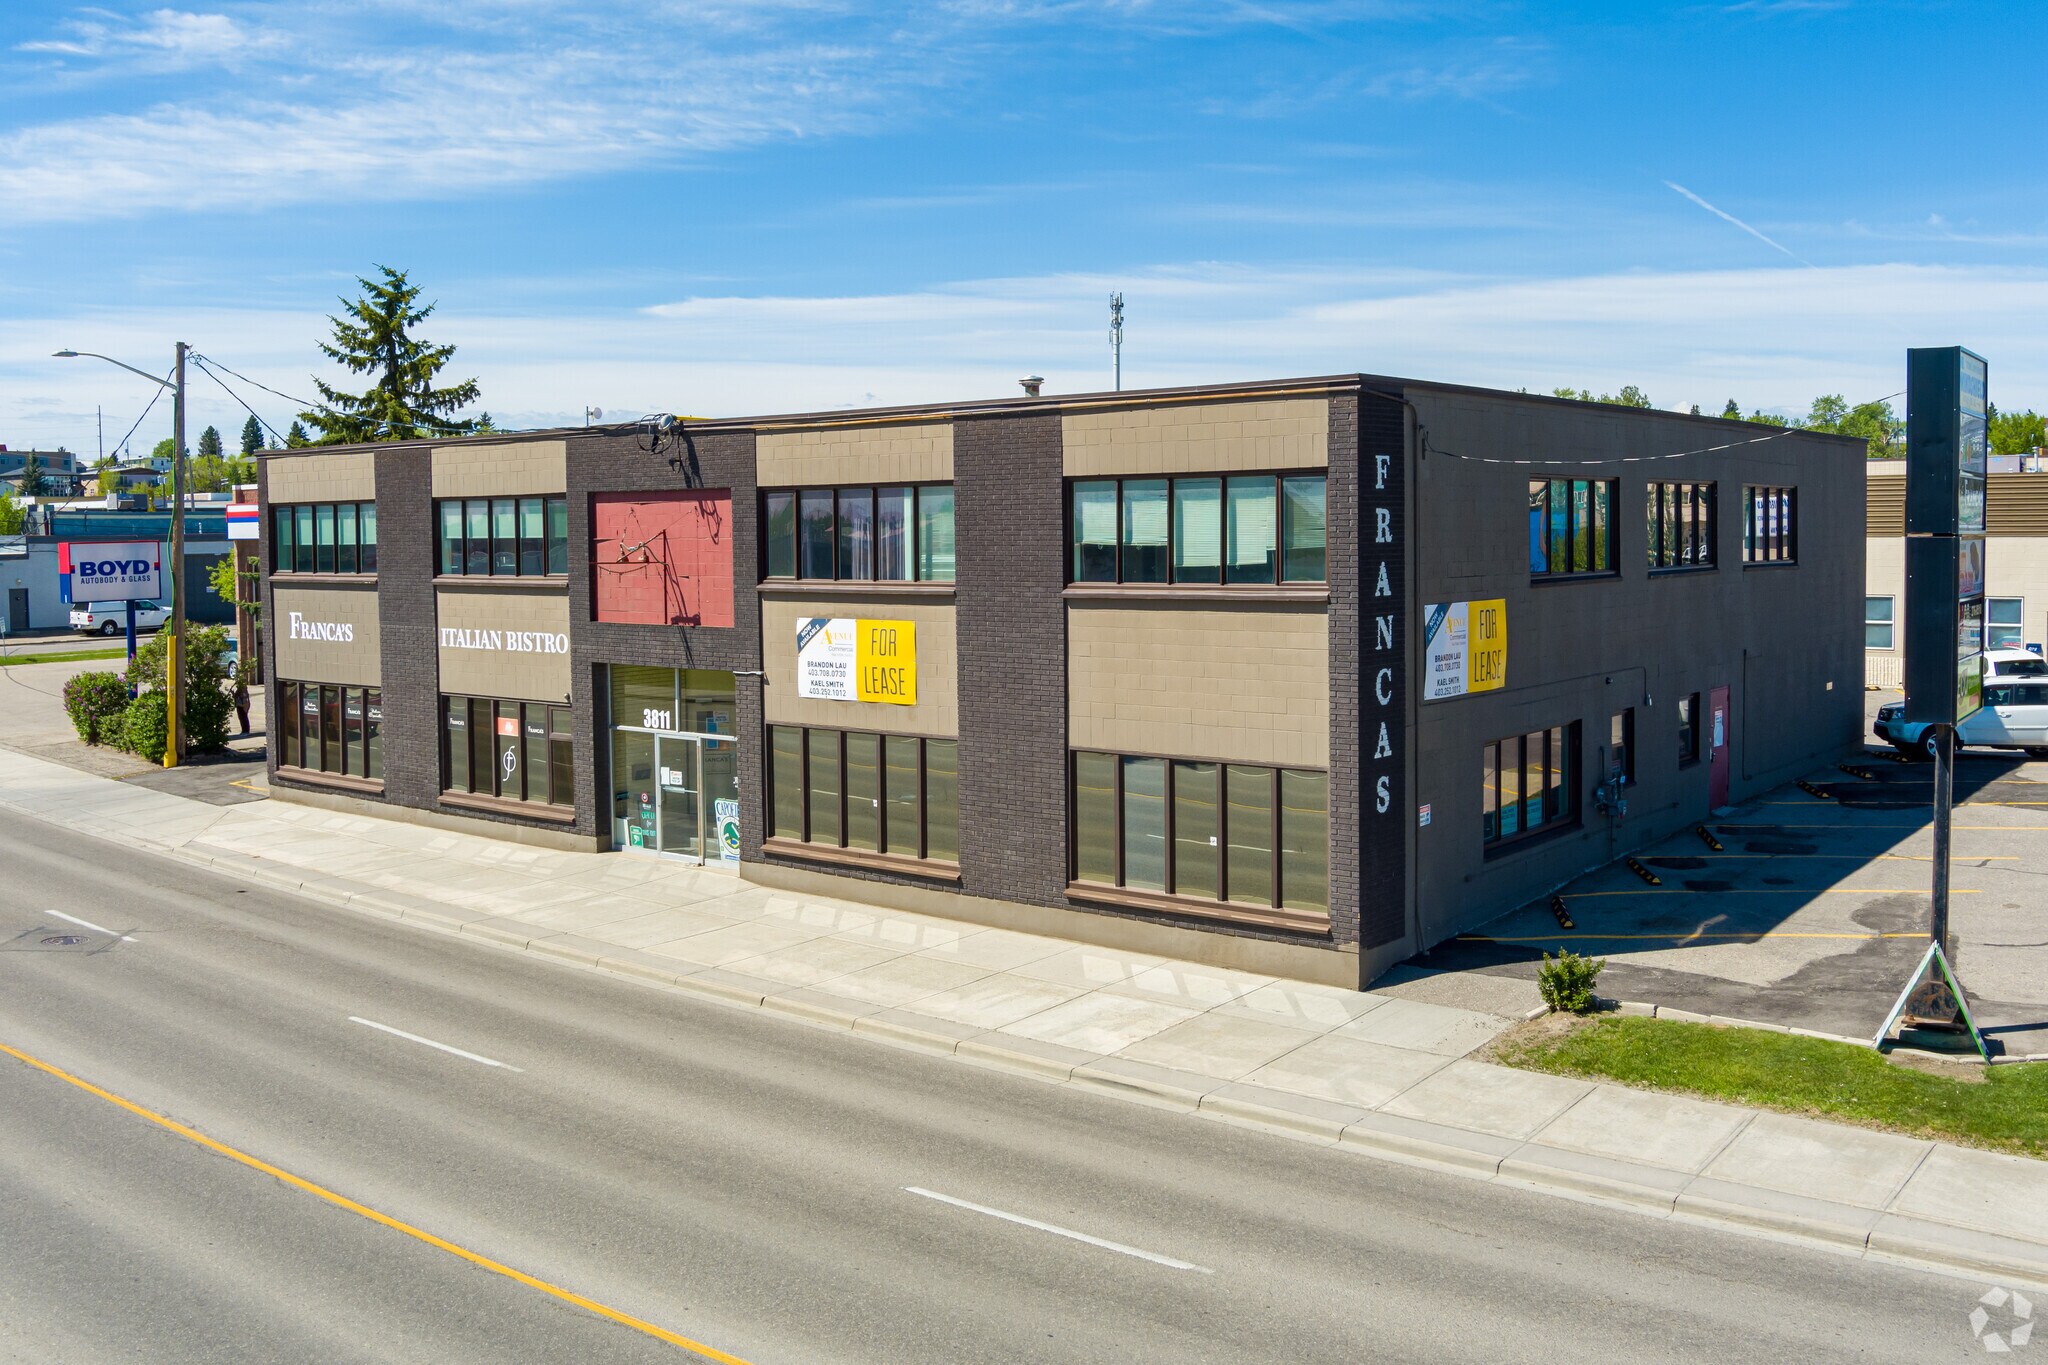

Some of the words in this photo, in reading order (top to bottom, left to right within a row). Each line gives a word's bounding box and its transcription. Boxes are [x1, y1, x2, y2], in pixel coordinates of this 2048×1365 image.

[79, 560, 150, 577] BOYD
[80, 576, 119, 585] AUTOBODY
[121, 575, 126, 583] &
[128, 575, 151, 583] GLASS
[288, 611, 354, 642] FRANCA'S
[800, 623, 812, 637] NOW
[1480, 608, 1498, 640] FOR
[440, 627, 501, 650] ITALIAN
[505, 630, 569, 654] BISTRO
[799, 623, 821, 647] AVAILABLE
[871, 628, 897, 657] FOR
[1374, 455, 1394, 813] FRANCAS
[807, 660, 834, 669] BRANDON
[1434, 653, 1453, 663] BRANDON
[1453, 651, 1462, 660] LAU
[1474, 649, 1502, 683] LEASE
[808, 669, 847, 678] 403.708.0730
[864, 666, 906, 696] LEASE
[1436, 678, 1448, 687] KAEL
[1448, 675, 1460, 685] SMITH
[809, 687, 847, 697] 403.252.1012
[826, 680, 844, 688] SMITH
[643, 708, 671, 730] 3811
